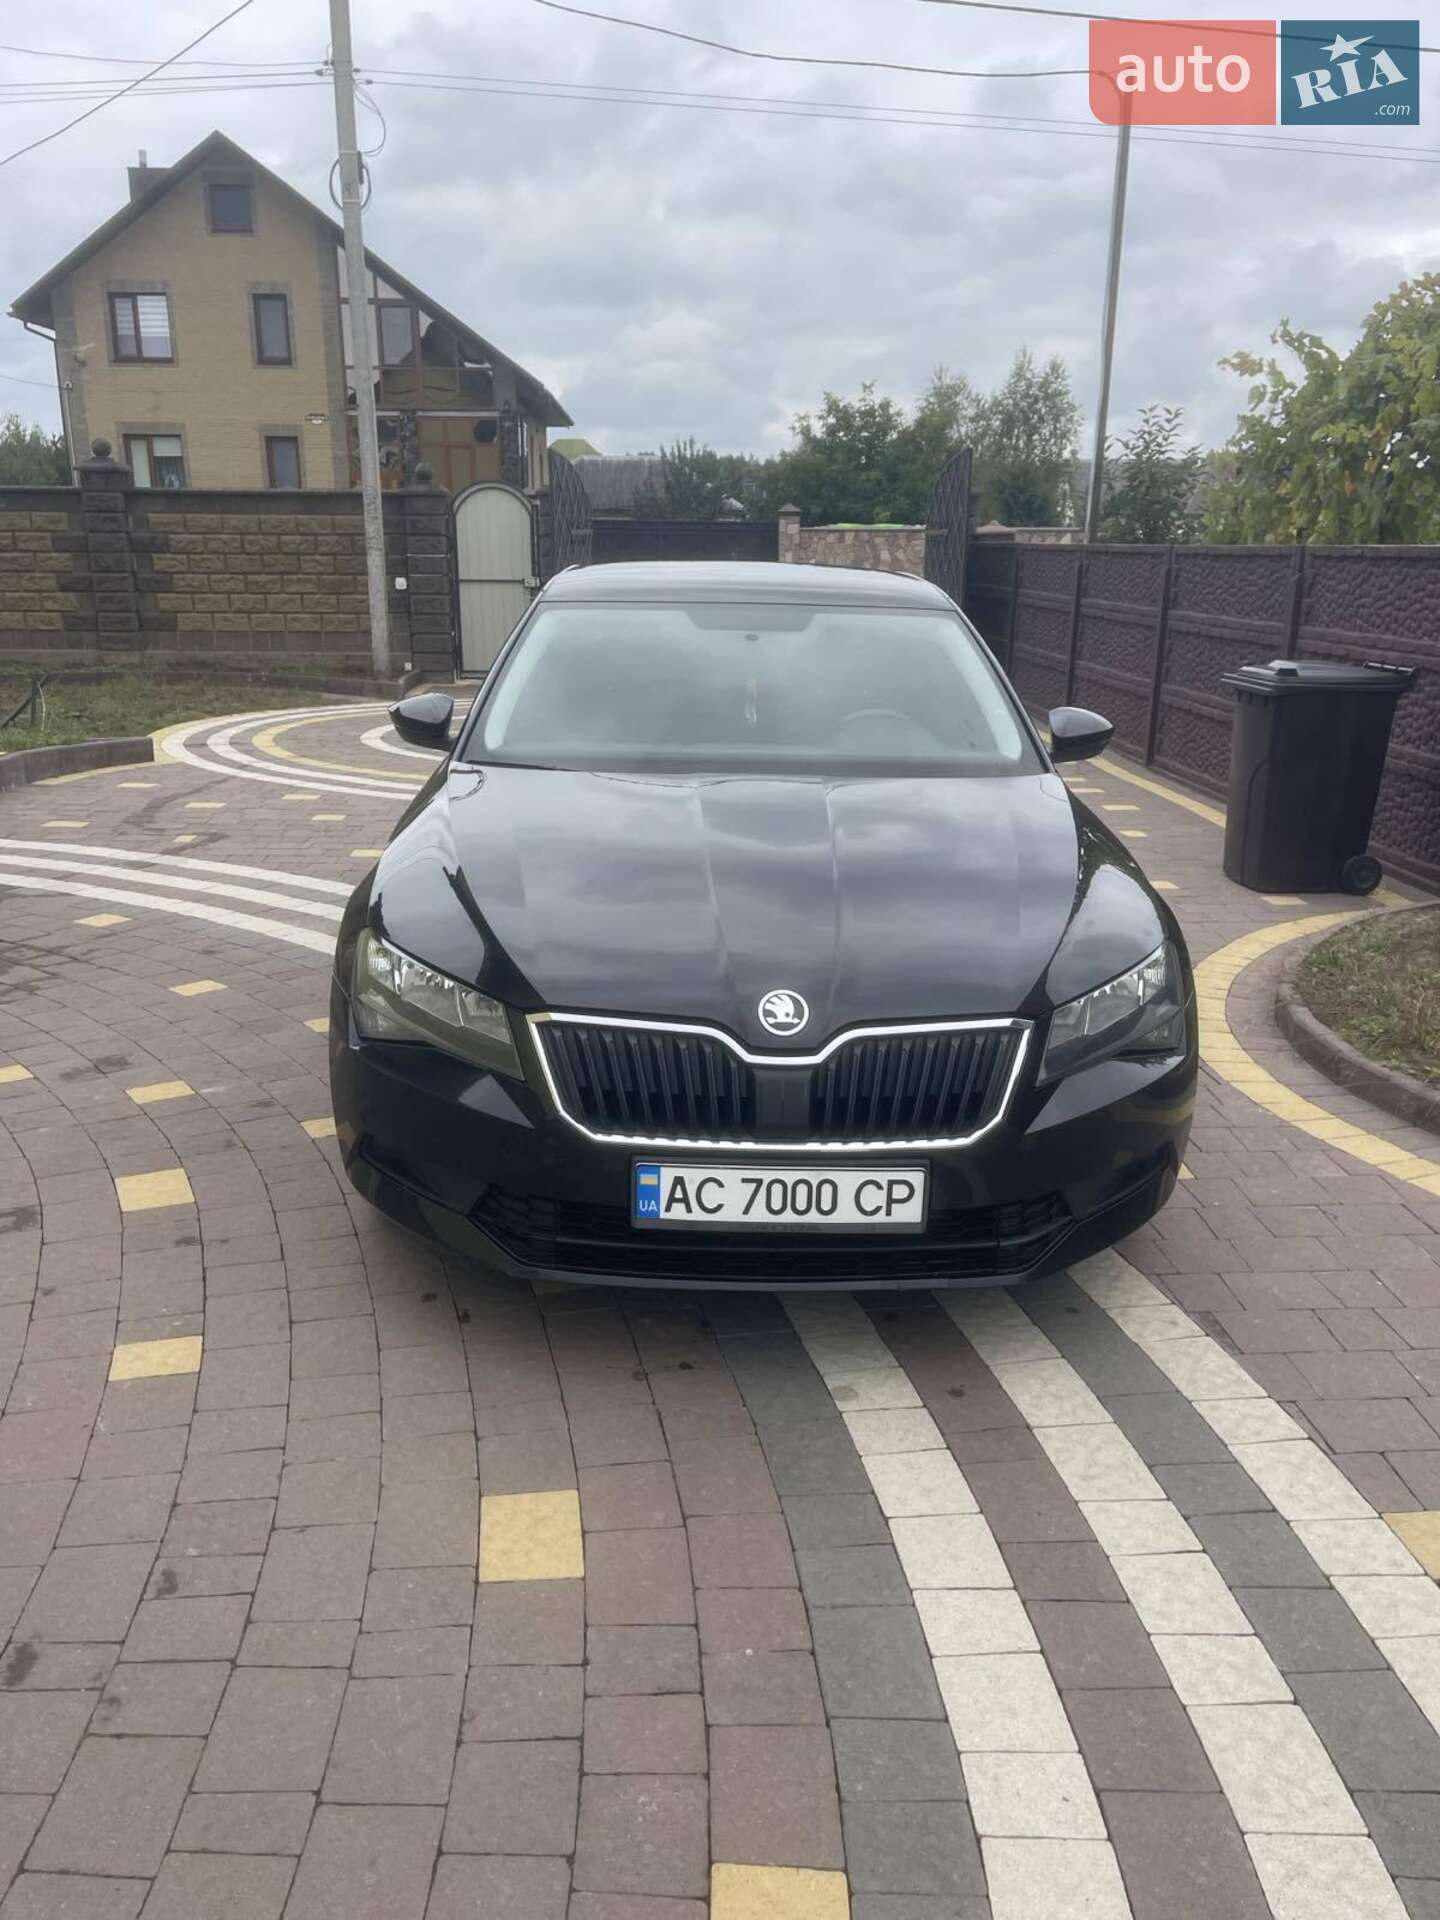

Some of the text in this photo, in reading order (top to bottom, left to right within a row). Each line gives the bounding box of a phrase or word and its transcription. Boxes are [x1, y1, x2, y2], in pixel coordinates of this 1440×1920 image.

[639, 1199, 658, 1212] UA
[664, 1175, 916, 1217] AC 7000 CP
